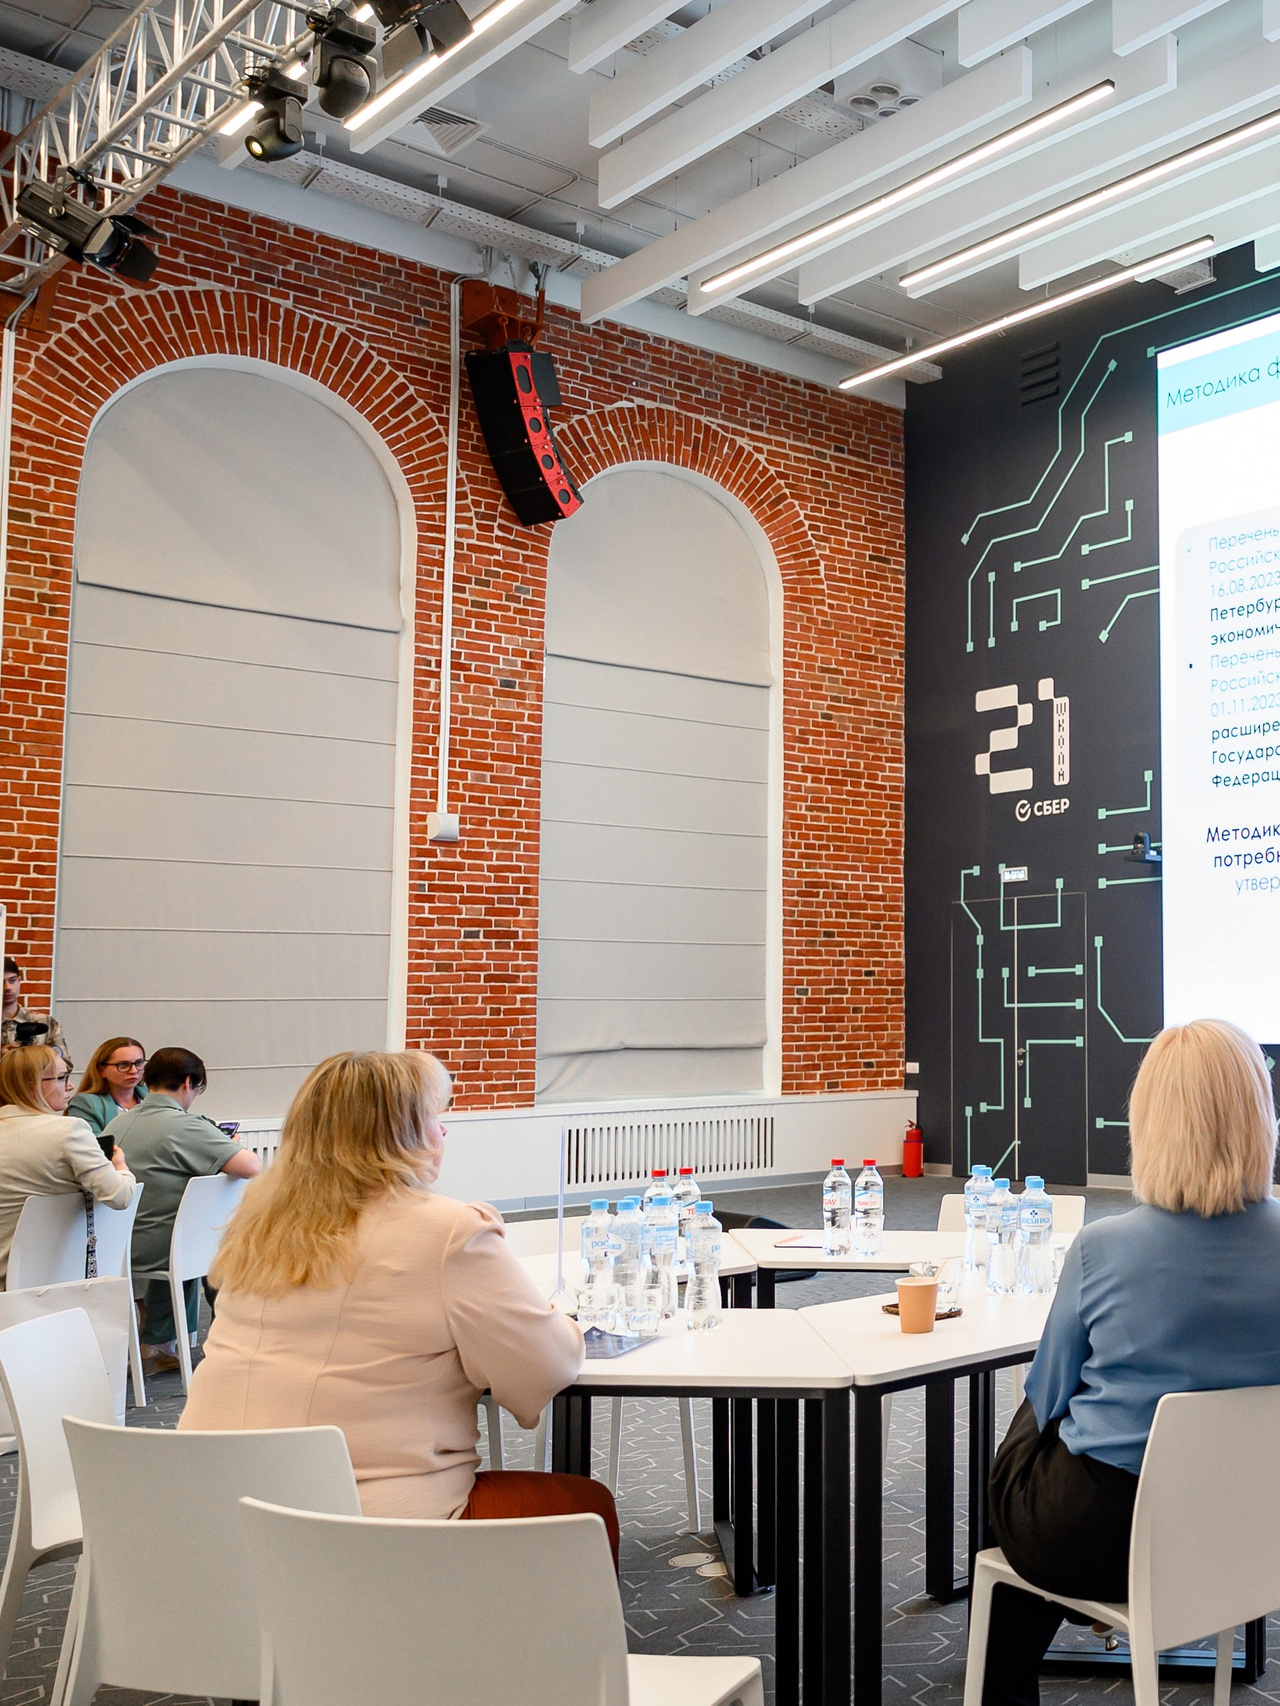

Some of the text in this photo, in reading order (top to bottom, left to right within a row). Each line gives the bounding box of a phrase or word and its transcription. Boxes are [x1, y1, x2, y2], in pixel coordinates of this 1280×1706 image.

[1166, 367, 1261, 408] Методика
[1208, 527, 1280, 551] Перечень
[1033, 798, 1070, 816] СБЕР
